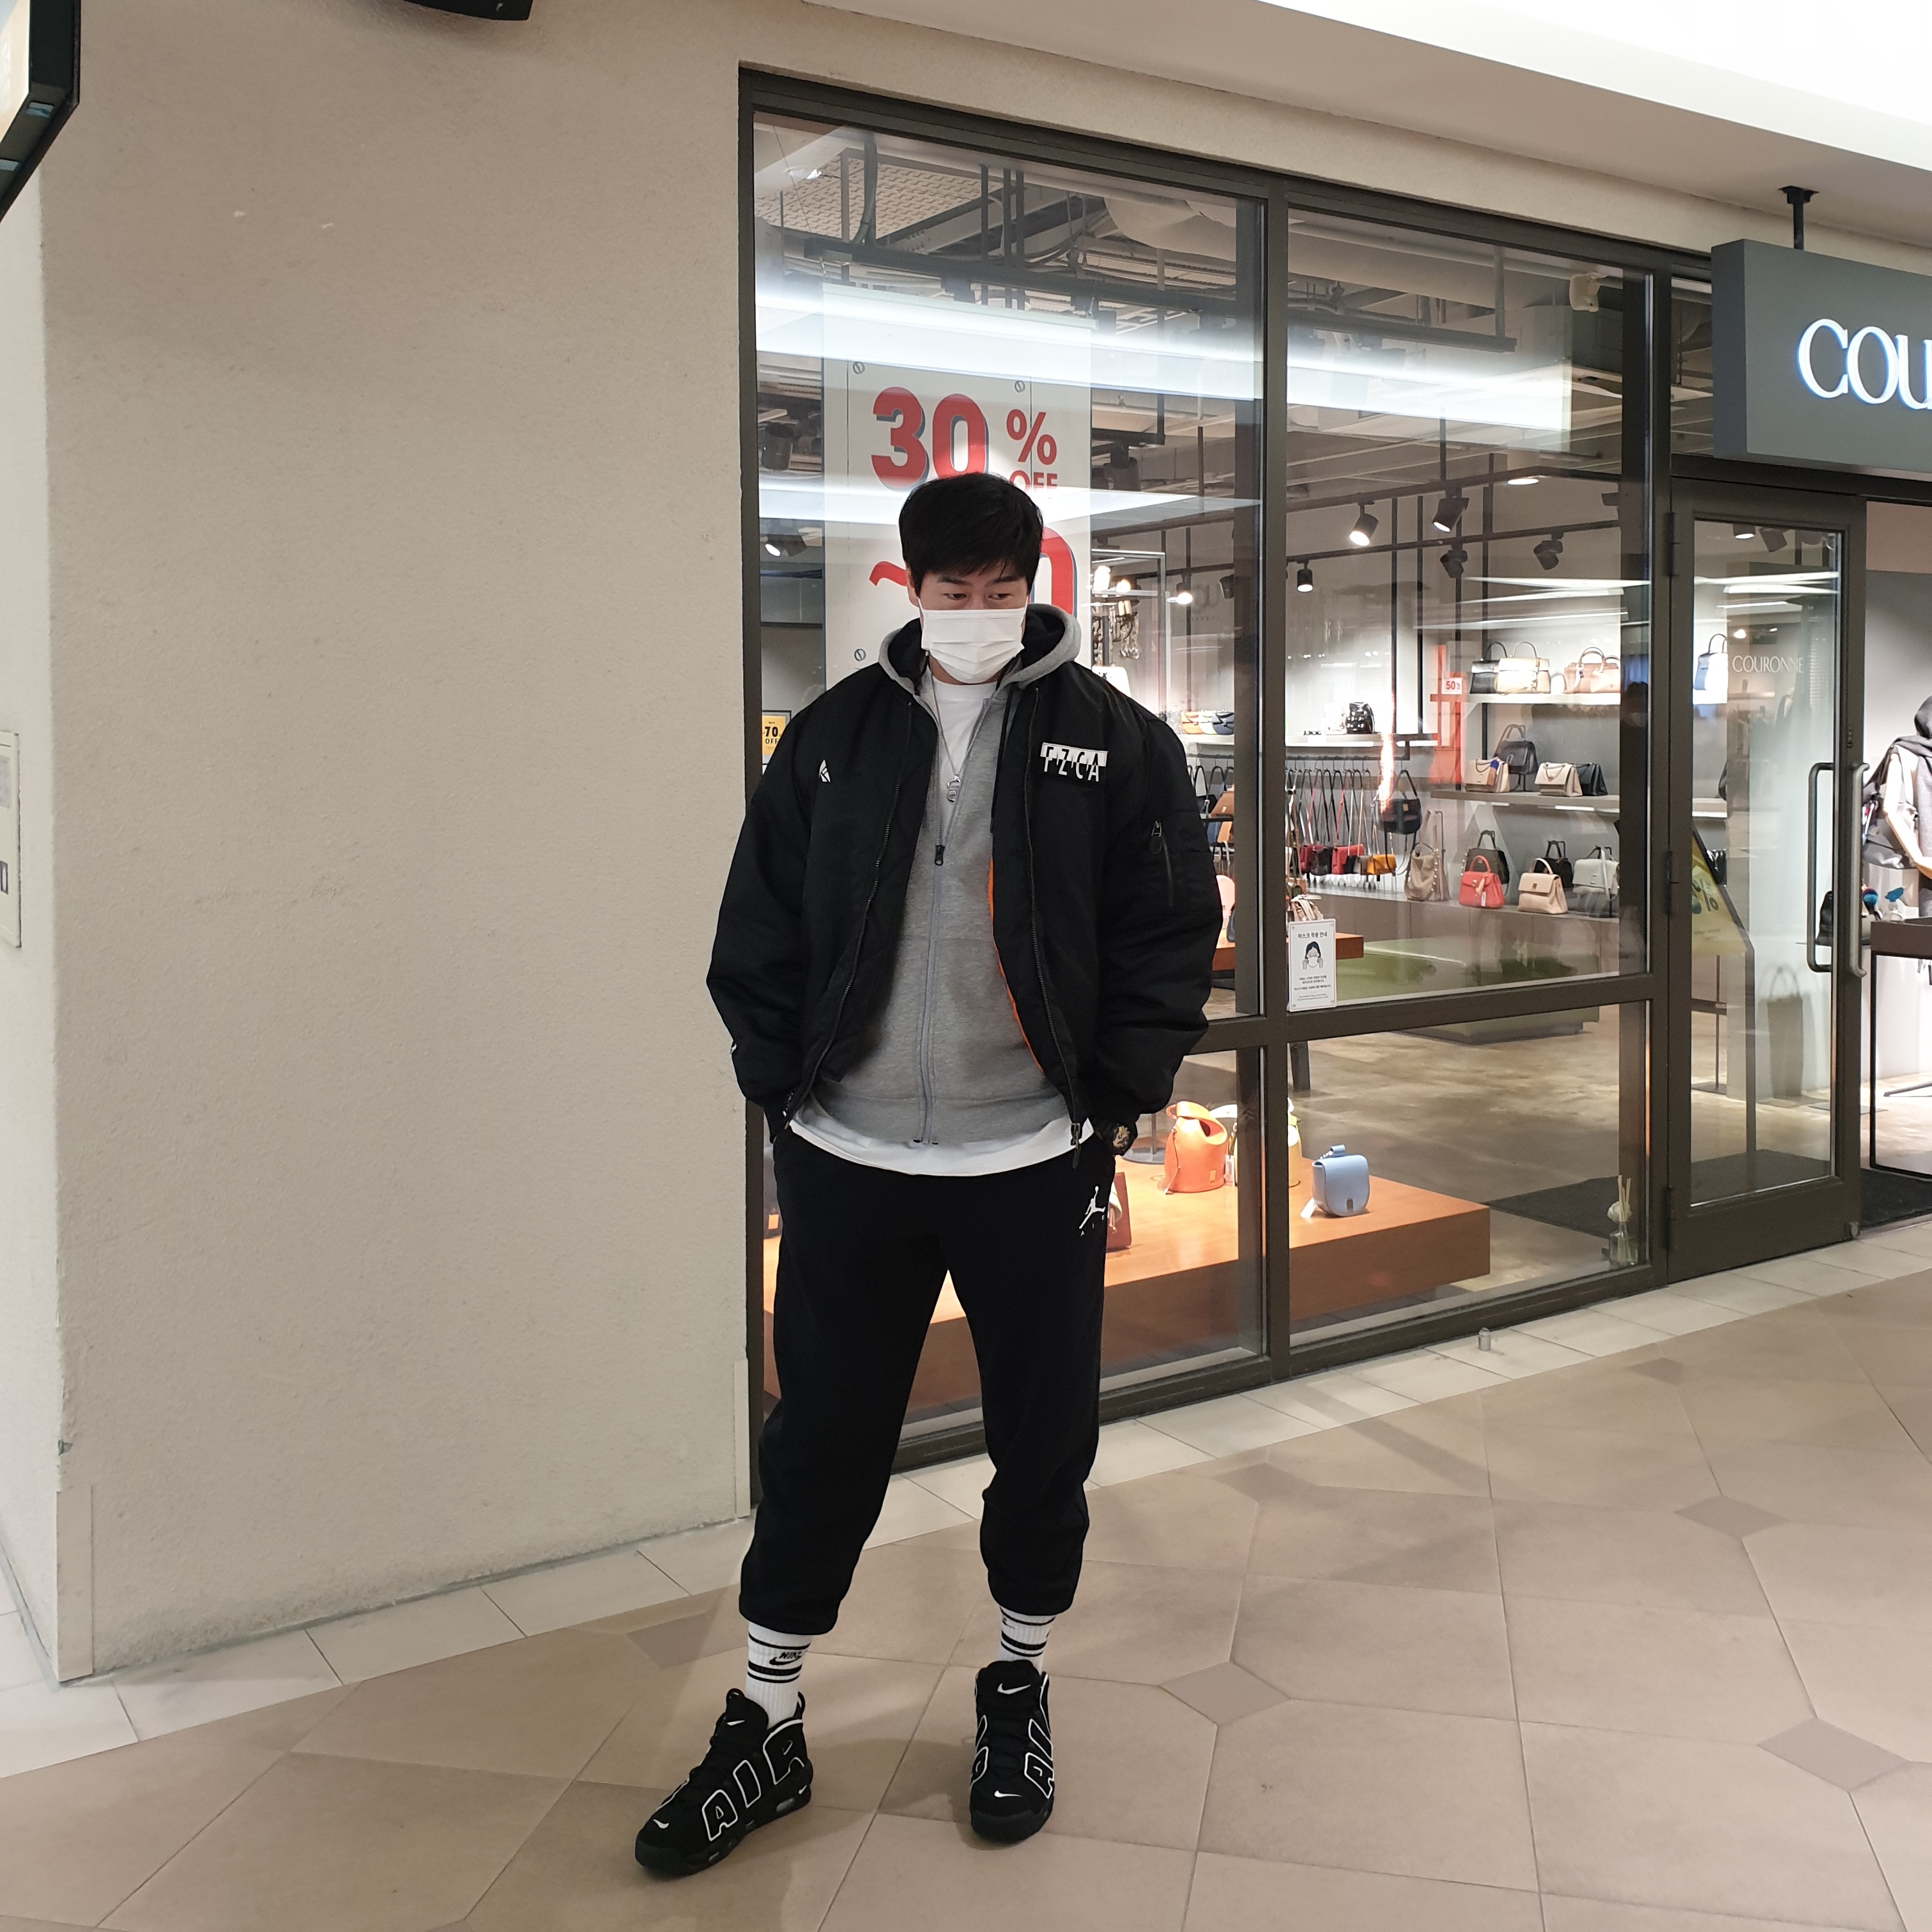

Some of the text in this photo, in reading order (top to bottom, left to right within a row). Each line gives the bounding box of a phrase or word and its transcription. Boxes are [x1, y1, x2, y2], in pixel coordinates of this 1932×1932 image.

[1797, 318, 1932, 410] COU
[1732, 655, 1804, 673] COURONNE
[765, 726, 778, 737] 70
